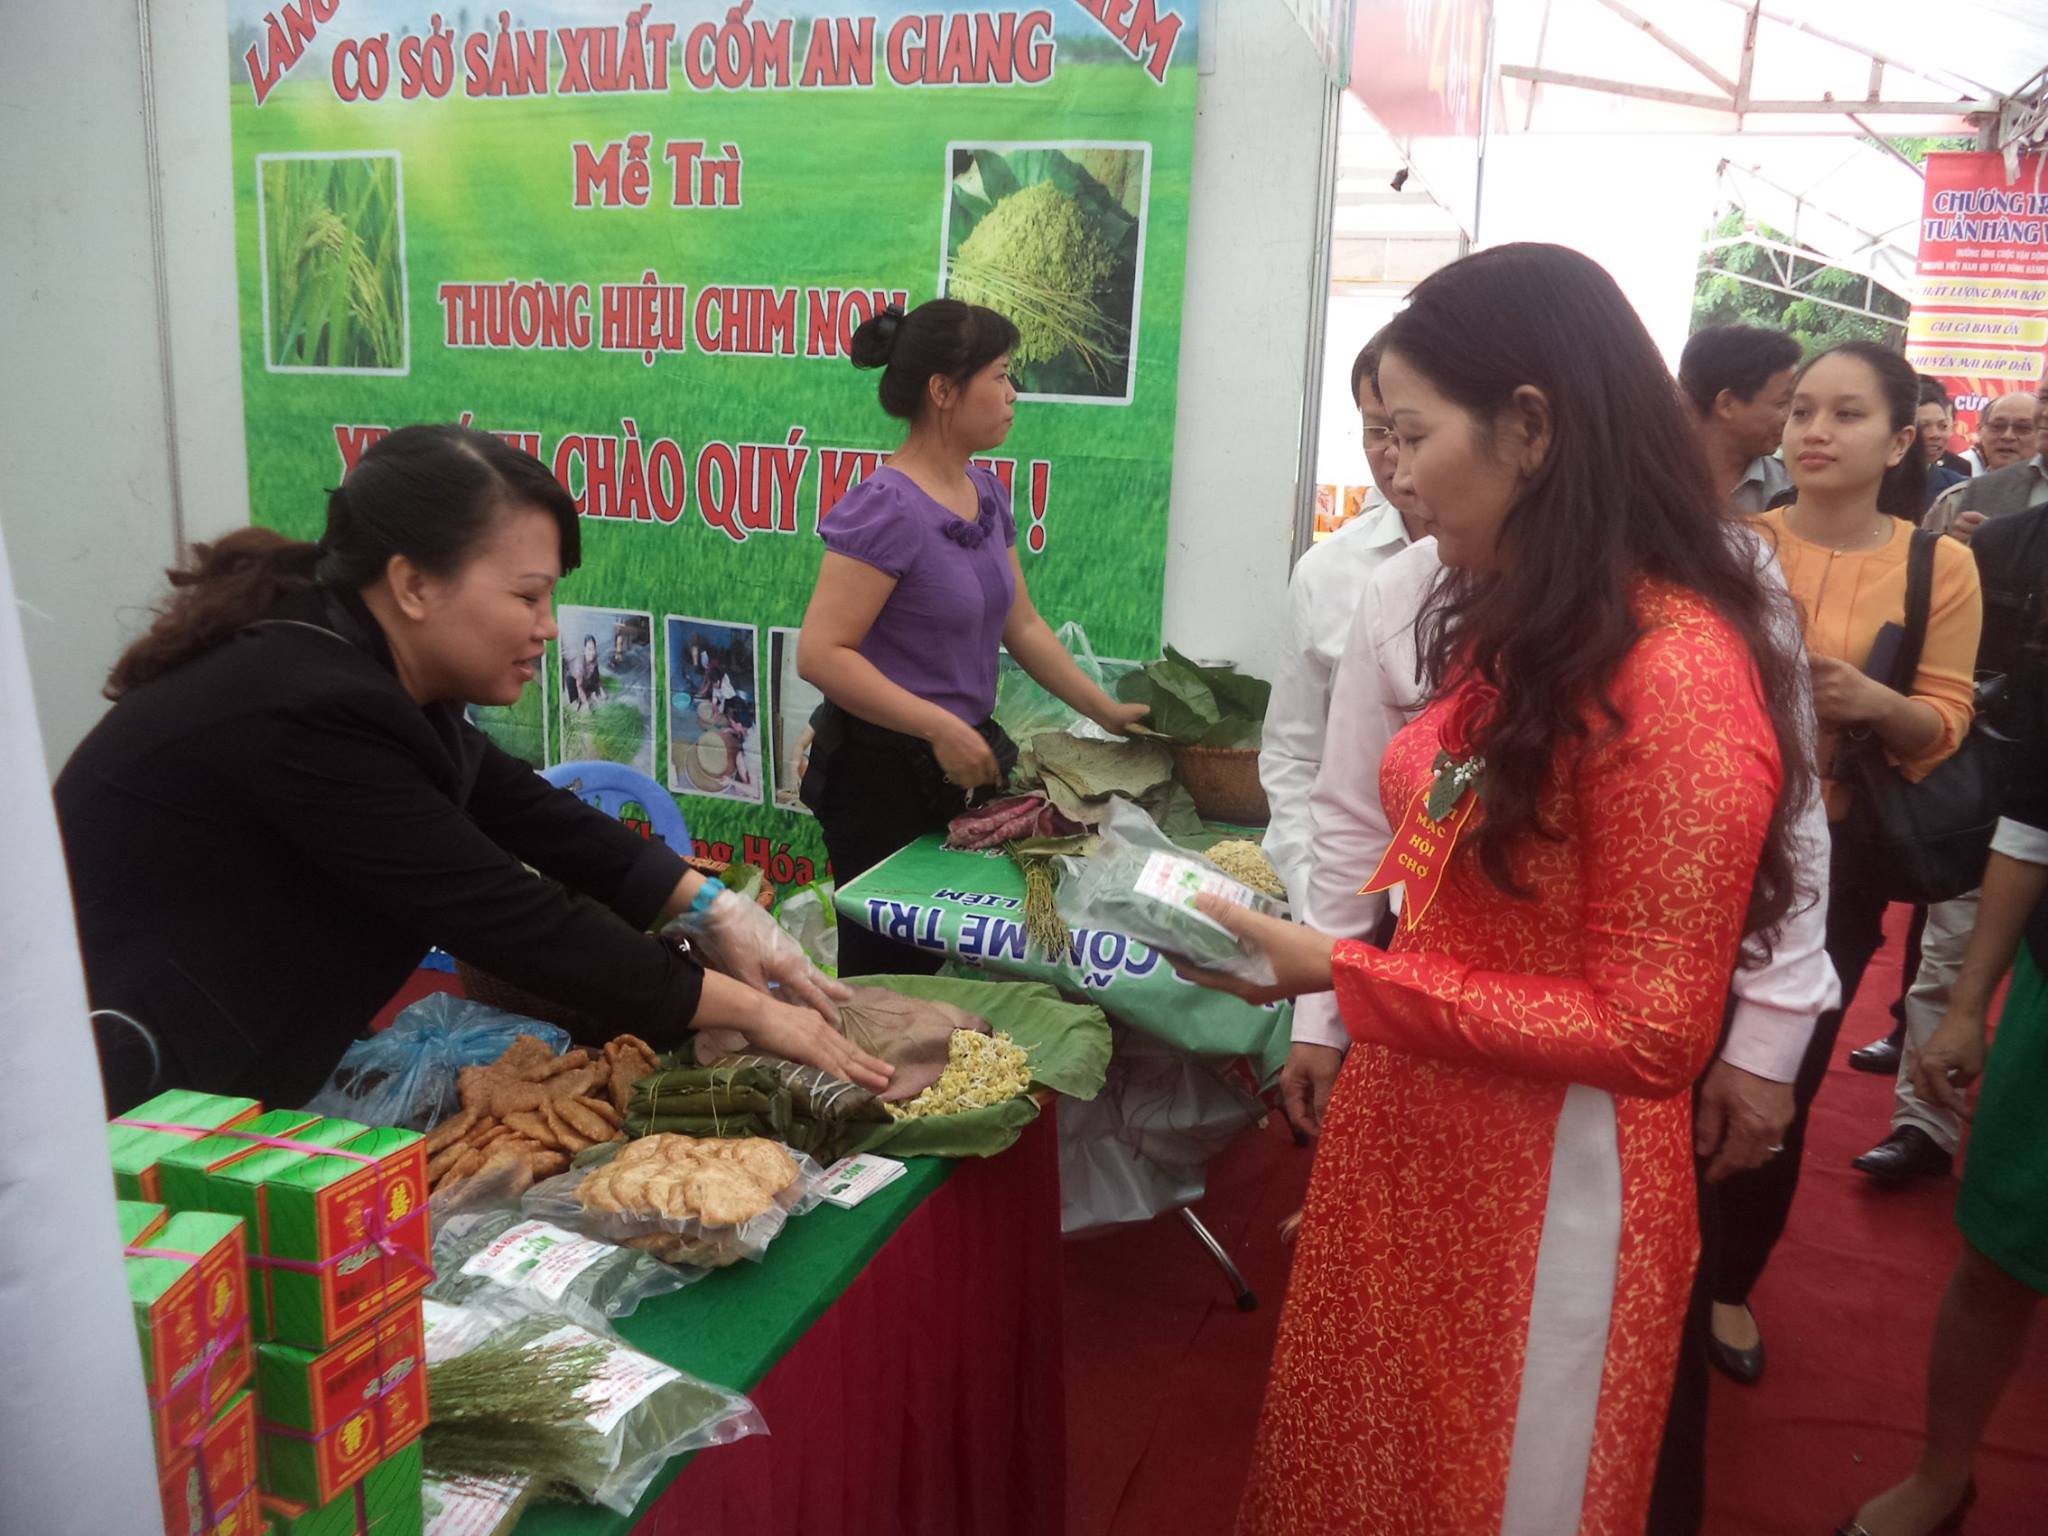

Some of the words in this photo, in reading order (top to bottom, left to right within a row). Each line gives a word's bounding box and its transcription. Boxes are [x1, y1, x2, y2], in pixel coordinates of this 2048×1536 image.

[332, 33, 389, 102] CƠ
[400, 14, 455, 99] SỞ
[464, 11, 548, 97] SẢN
[557, 4, 675, 93] XUẤT
[684, 0, 791, 89] CỐM
[800, 16, 876, 86] AN
[886, 11, 1053, 84] GIANG
[573, 134, 650, 206] Mễ
[666, 142, 741, 205] Trì
[1934, 189, 2023, 215] CHƯƠNG
[1981, 217, 2039, 243] HÀNG
[440, 280, 590, 348] THƯƠNG
[602, 272, 684, 365] HIỆU
[695, 287, 798, 355] CHIM
[555, 419, 685, 522] CHÀO
[699, 427, 805, 540] QUÝ
[1398, 853, 1429, 880] CHỢ
[1409, 834, 1436, 857] HỘI
